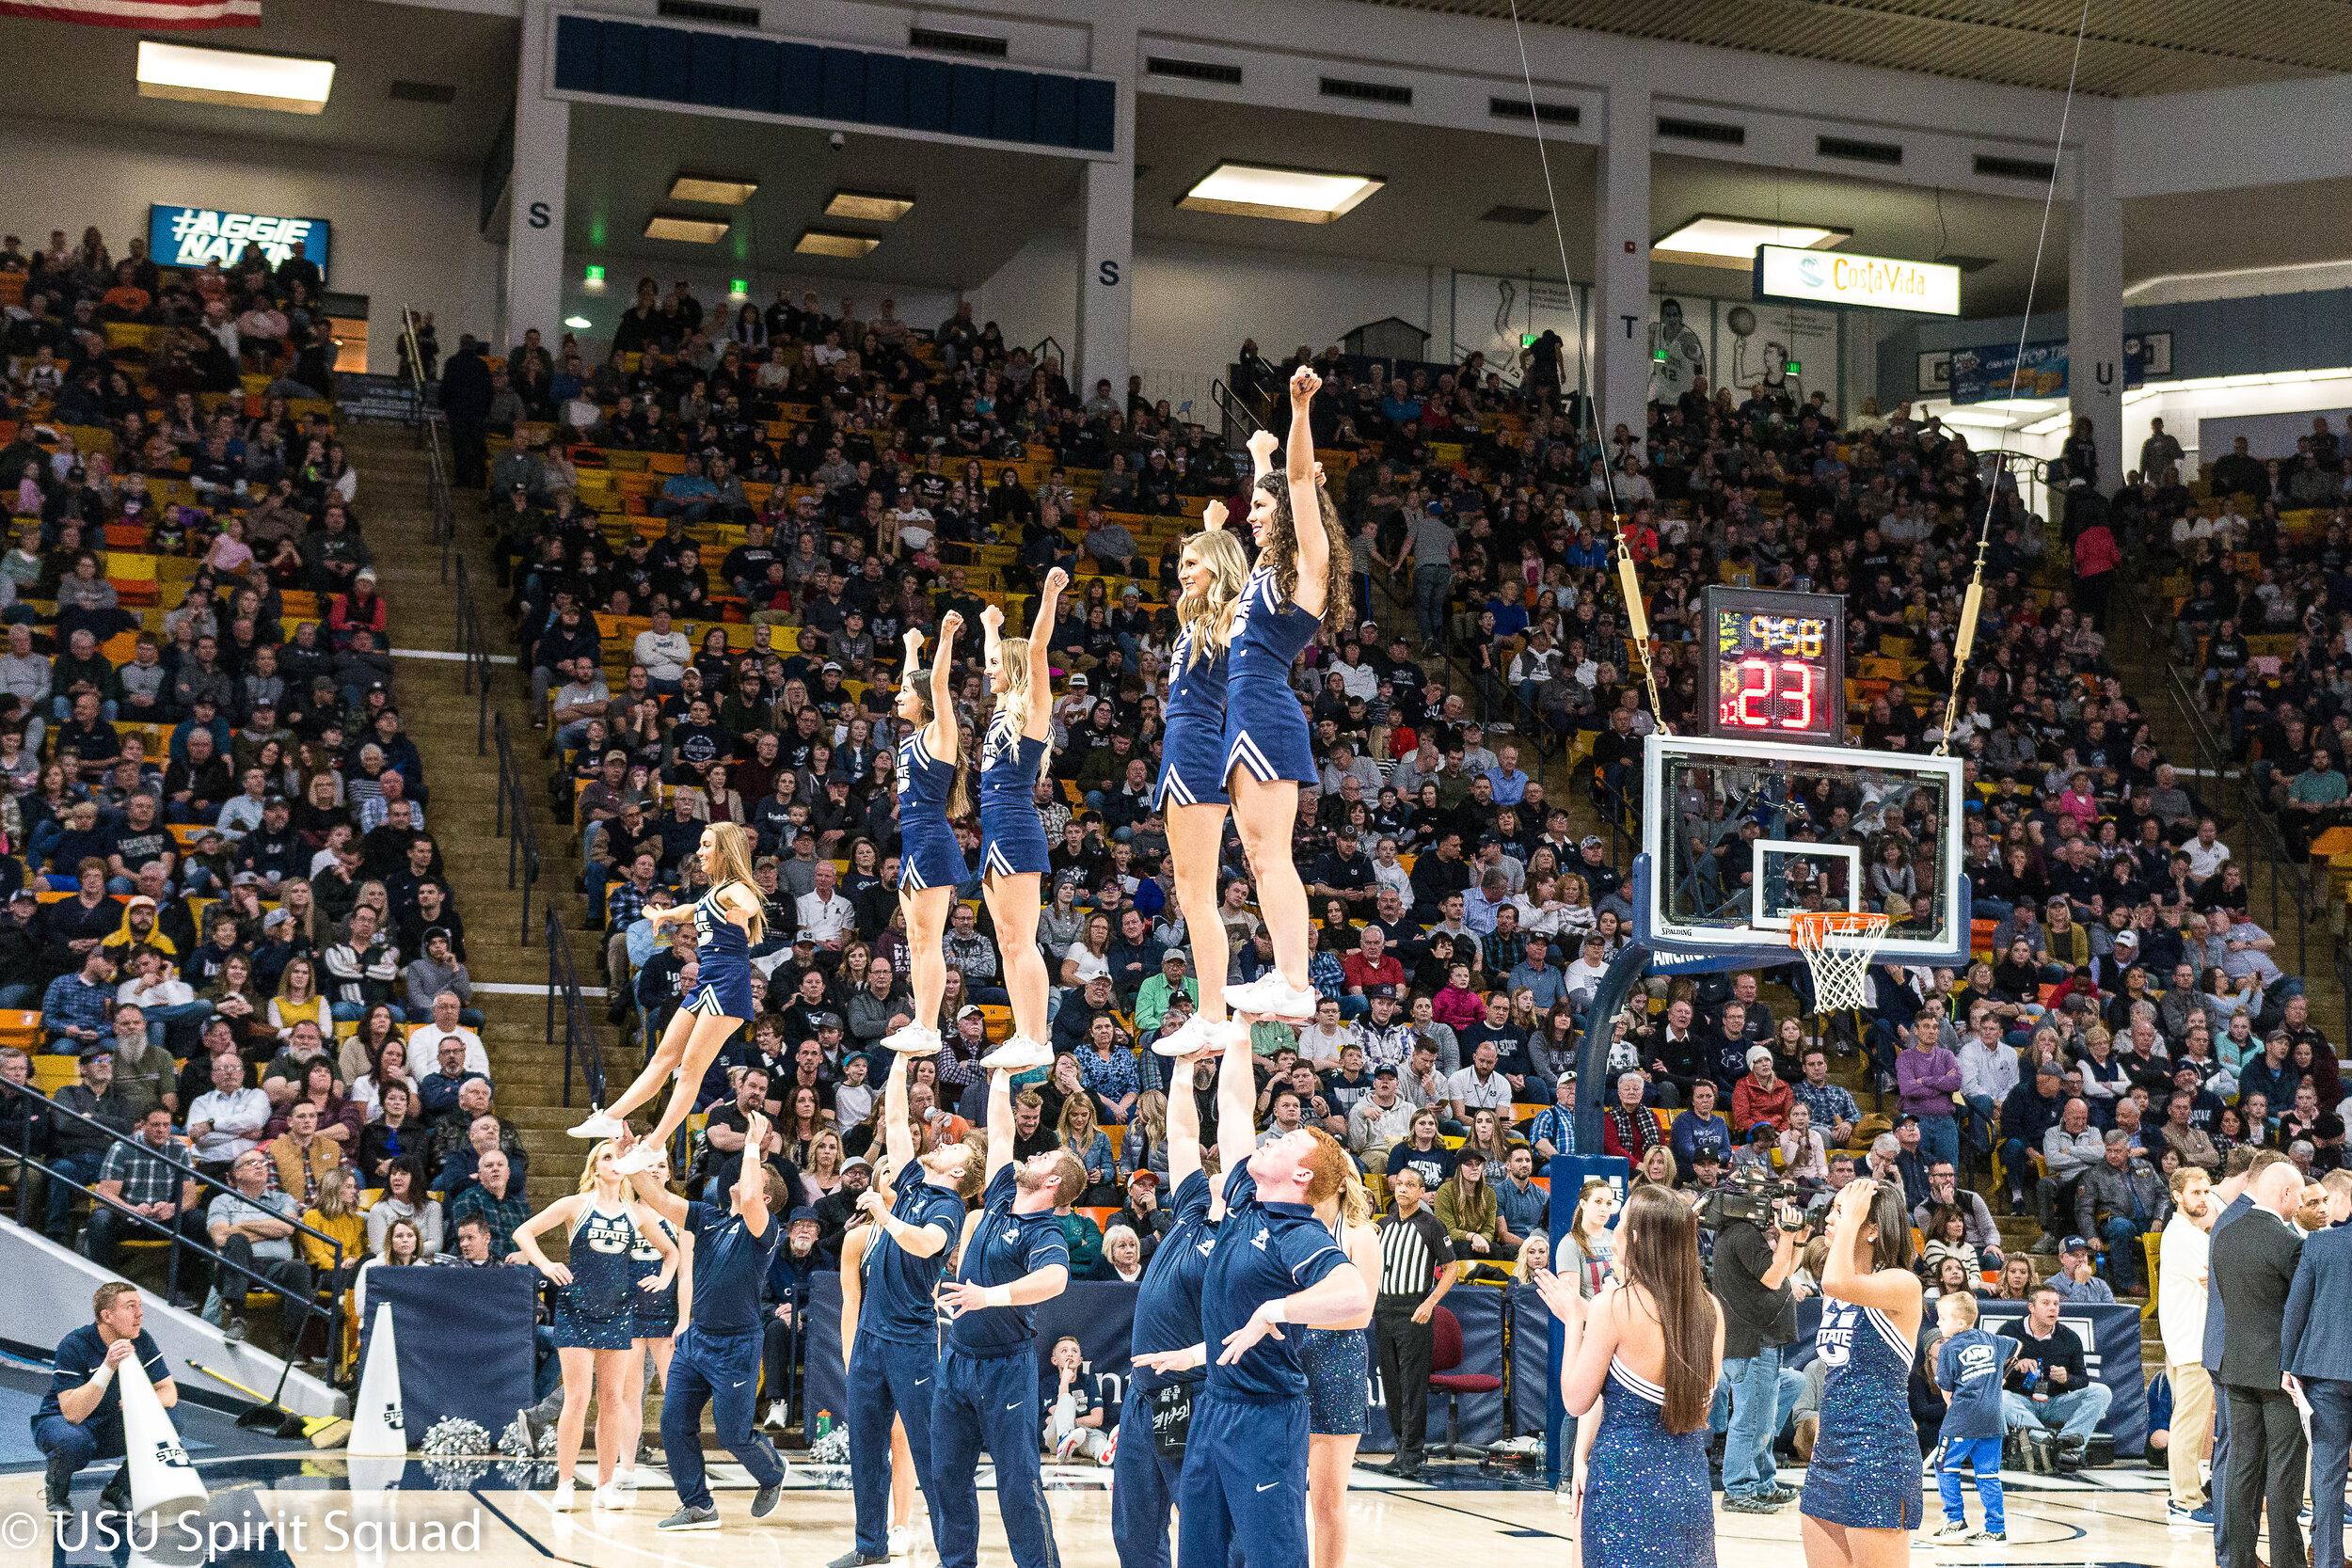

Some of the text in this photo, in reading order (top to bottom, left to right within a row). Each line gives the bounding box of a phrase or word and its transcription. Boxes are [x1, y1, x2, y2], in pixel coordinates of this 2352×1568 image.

[172, 209, 312, 245] #AGGIE
[528, 201, 551, 230] S
[1099, 260, 1120, 286] S
[1620, 315, 1638, 340] T
[2096, 361, 2113, 386] U
[1738, 659, 1811, 729] 23
[1661, 927, 1692, 937] SPALDING
[587, 1227, 630, 1244] STATE
[1815, 1328, 1854, 1349] STATE
